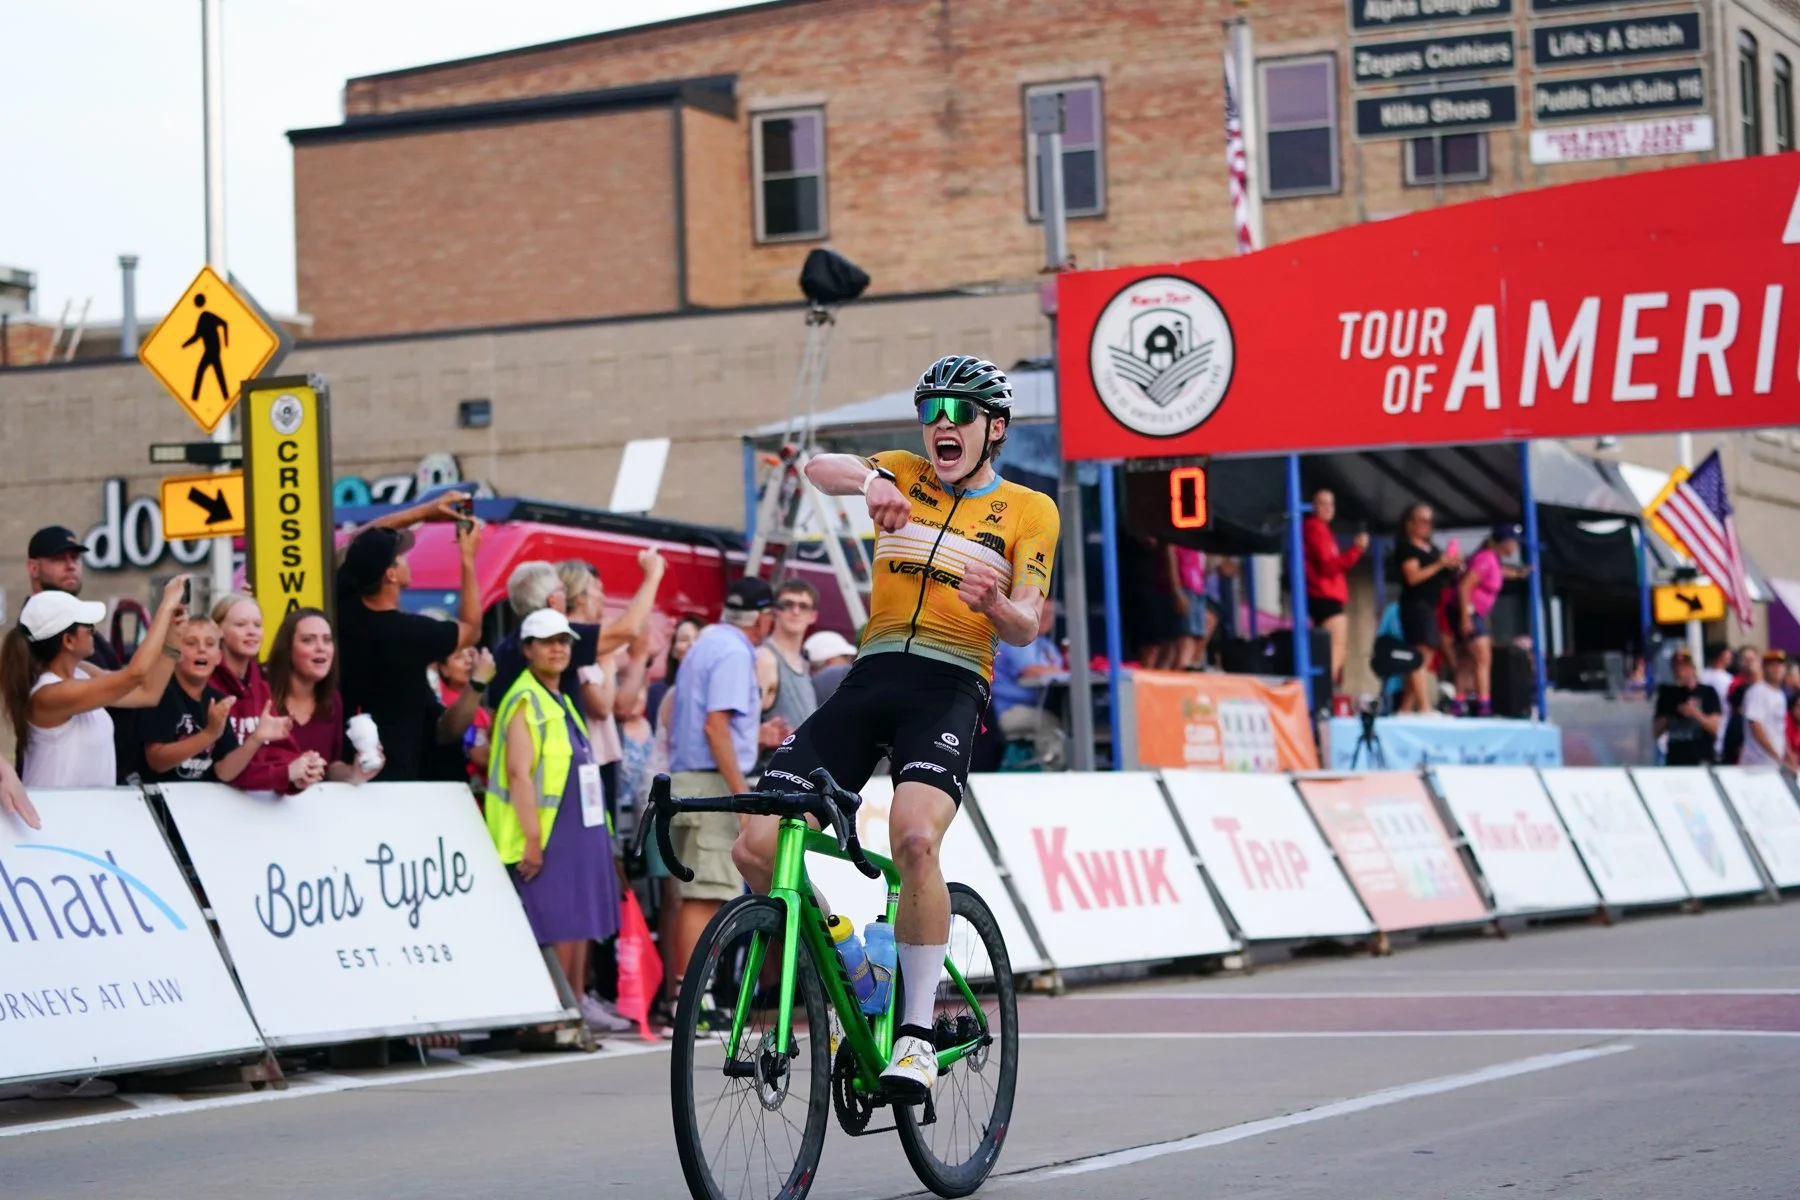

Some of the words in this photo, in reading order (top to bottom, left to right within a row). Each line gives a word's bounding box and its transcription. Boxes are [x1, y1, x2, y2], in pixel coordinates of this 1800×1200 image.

[1356, 51, 1423, 78] Zegers
[1425, 41, 1512, 69] Clothiers
[1548, 30, 1605, 57] Life's
[1606, 27, 1624, 51] A
[1625, 22, 1685, 49] Stitch
[1430, 97, 1491, 123] Shoes
[1339, 307, 1449, 362] TOUR
[1382, 364, 1438, 414] OF
[1445, 283, 1800, 412] AMERI
[1169, 467, 1206, 529] 0
[277, 440, 305, 617] CROSSWA
[764, 769, 815, 790] VERGE
[900, 761, 948, 774] ERGE
[1030, 826, 1181, 913] KWIK
[1211, 816, 1310, 891] TRIP
[255, 862, 364, 938] Ben's
[364, 836, 475, 930] Cycle
[401, 943, 453, 966] 1928
[98, 983, 127, 1012] AT
[133, 976, 185, 1008] LAW
